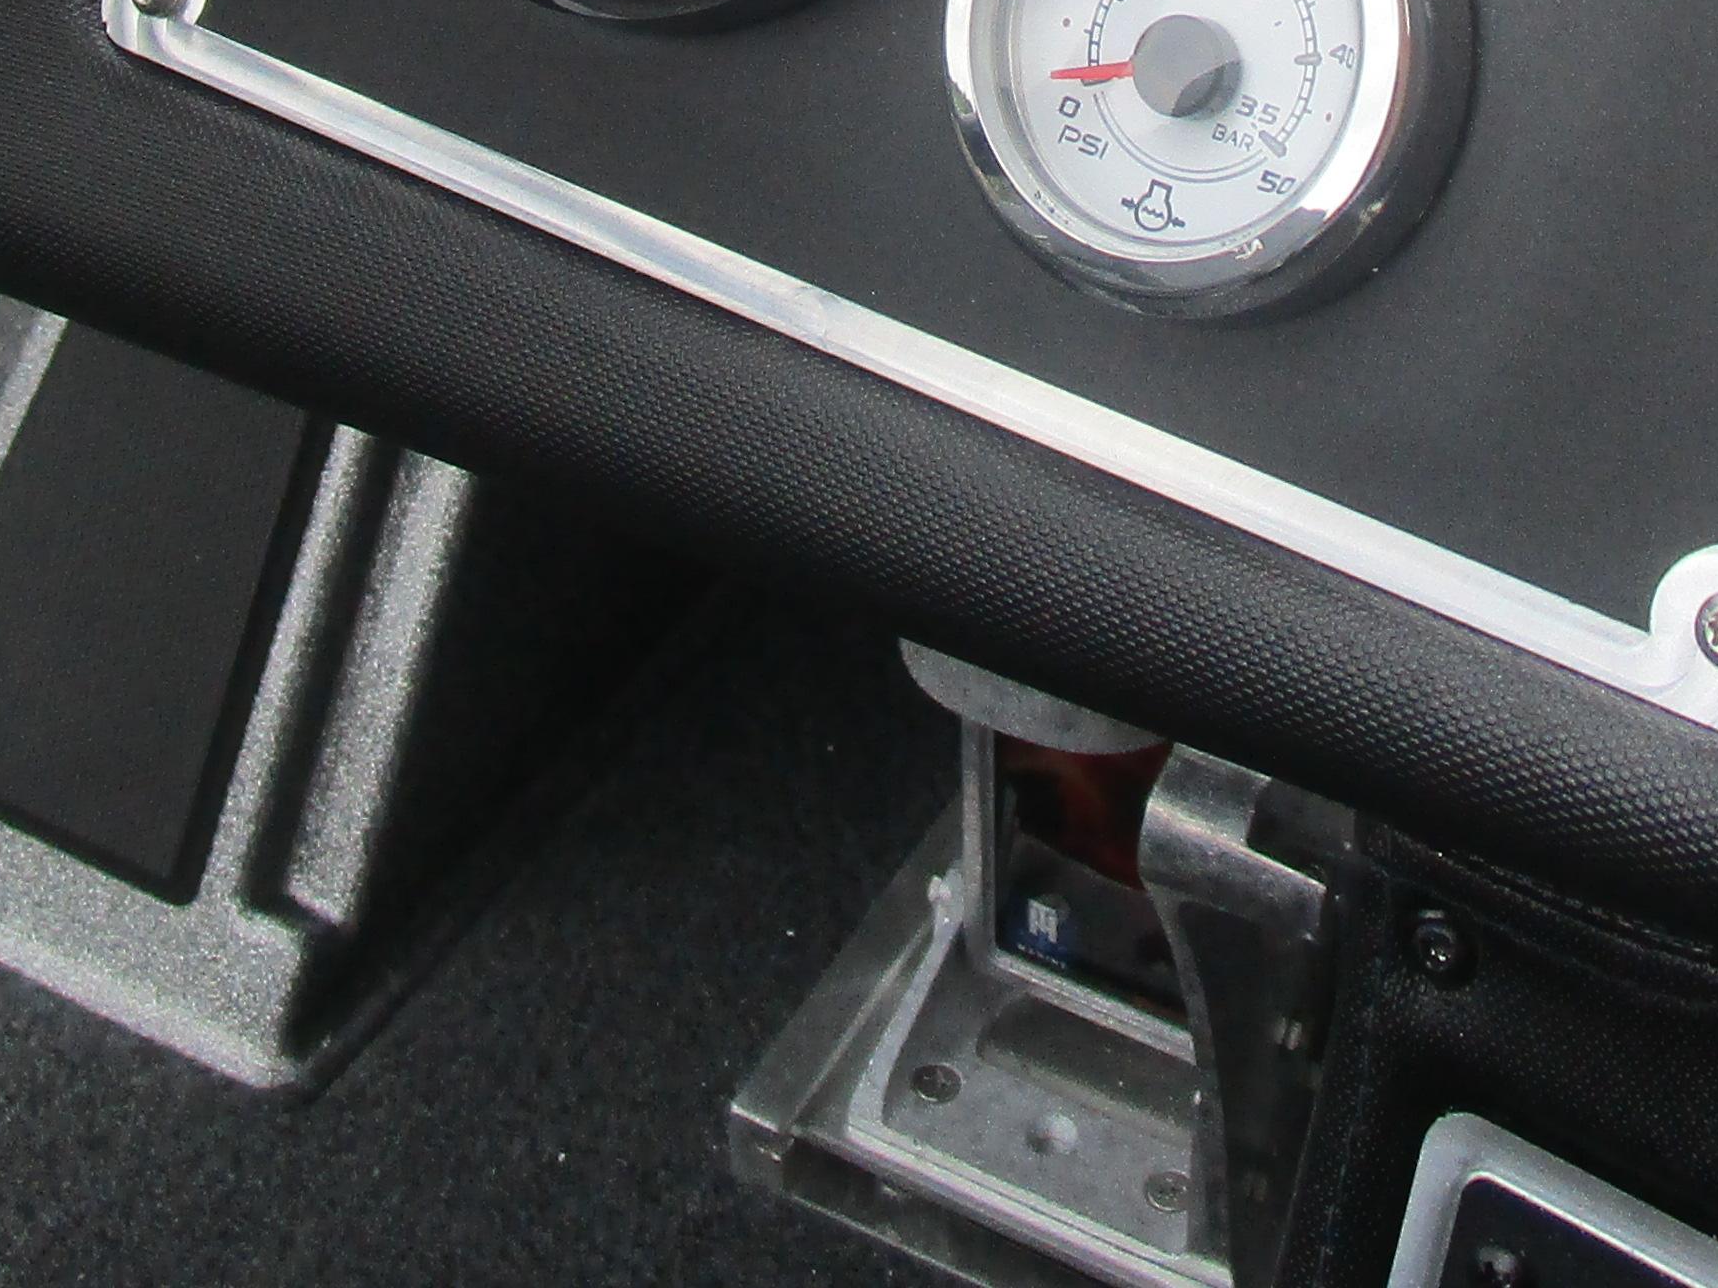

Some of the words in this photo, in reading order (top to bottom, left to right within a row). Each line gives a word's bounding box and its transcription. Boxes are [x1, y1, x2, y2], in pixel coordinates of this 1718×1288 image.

[1329, 43, 1355, 69] 40
[1058, 95, 1081, 118] 0
[1235, 94, 1281, 126] 3.5
[1058, 124, 1109, 160] PSI
[1211, 123, 1255, 152] BAR
[1257, 170, 1297, 195] 50
